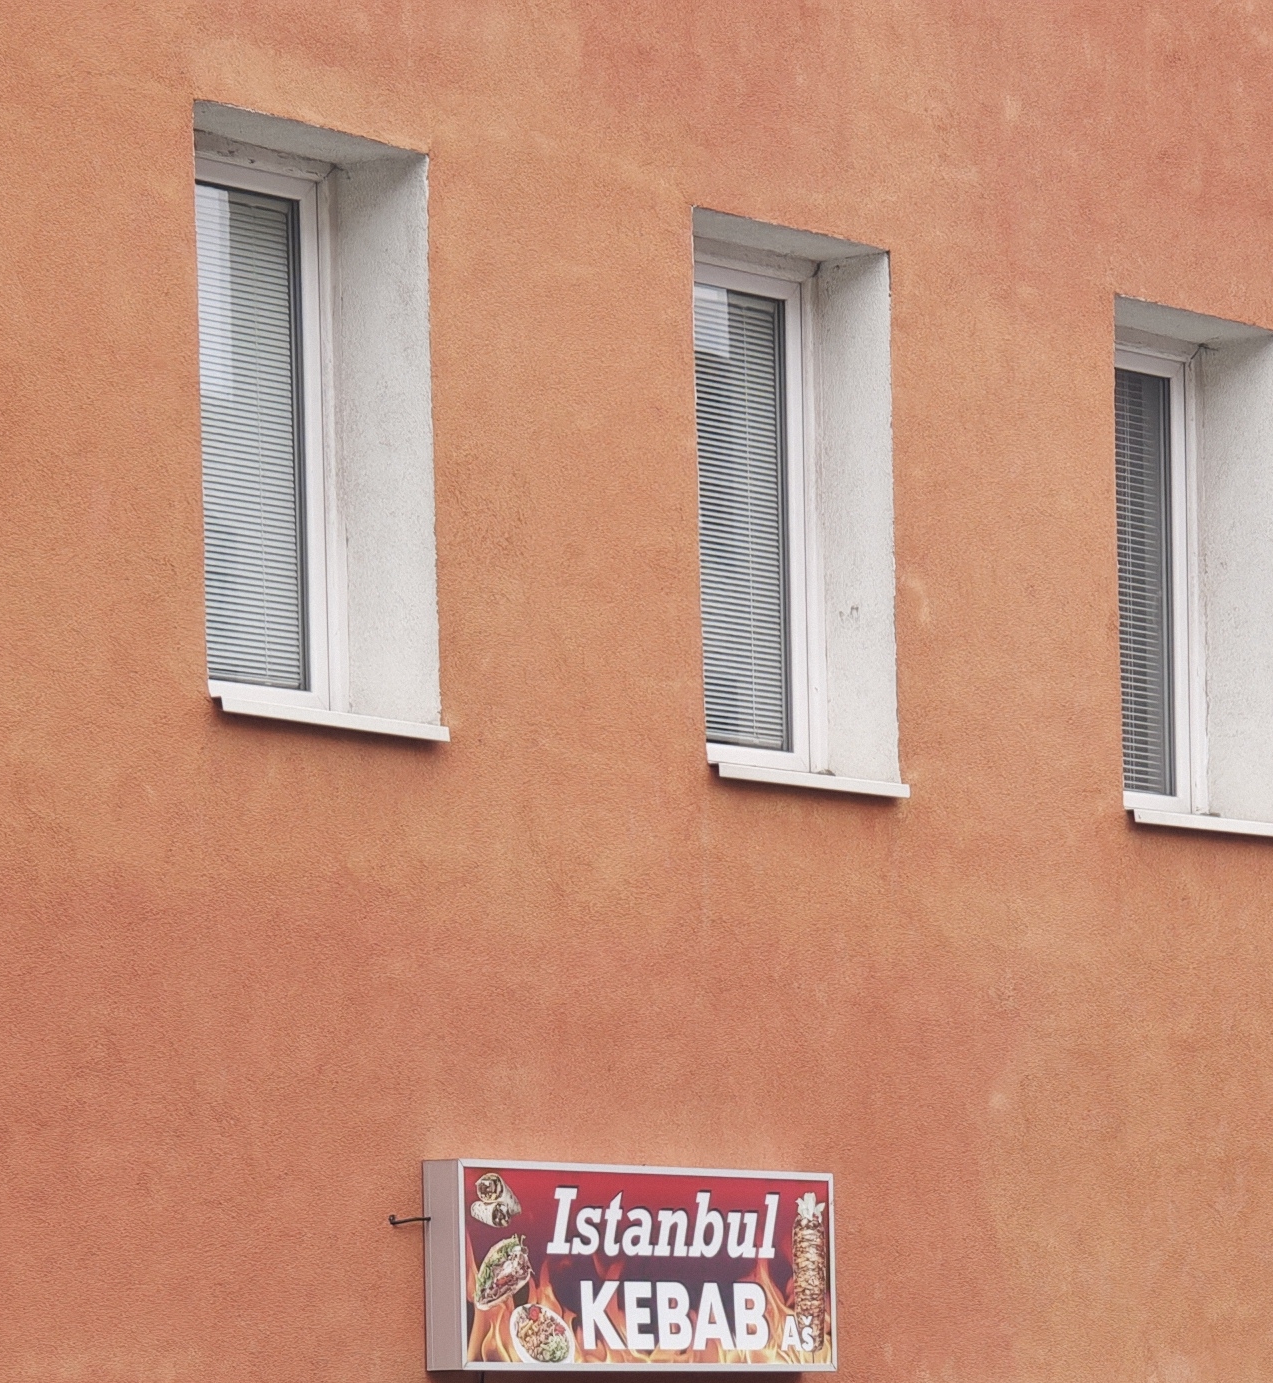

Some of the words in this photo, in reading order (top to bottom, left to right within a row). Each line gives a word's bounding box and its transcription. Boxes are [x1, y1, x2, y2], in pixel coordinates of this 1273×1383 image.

[546, 1186, 779, 1259] Istanbul
[580, 1280, 769, 1351] KEBAB
[781, 1314, 814, 1352] AŠ
